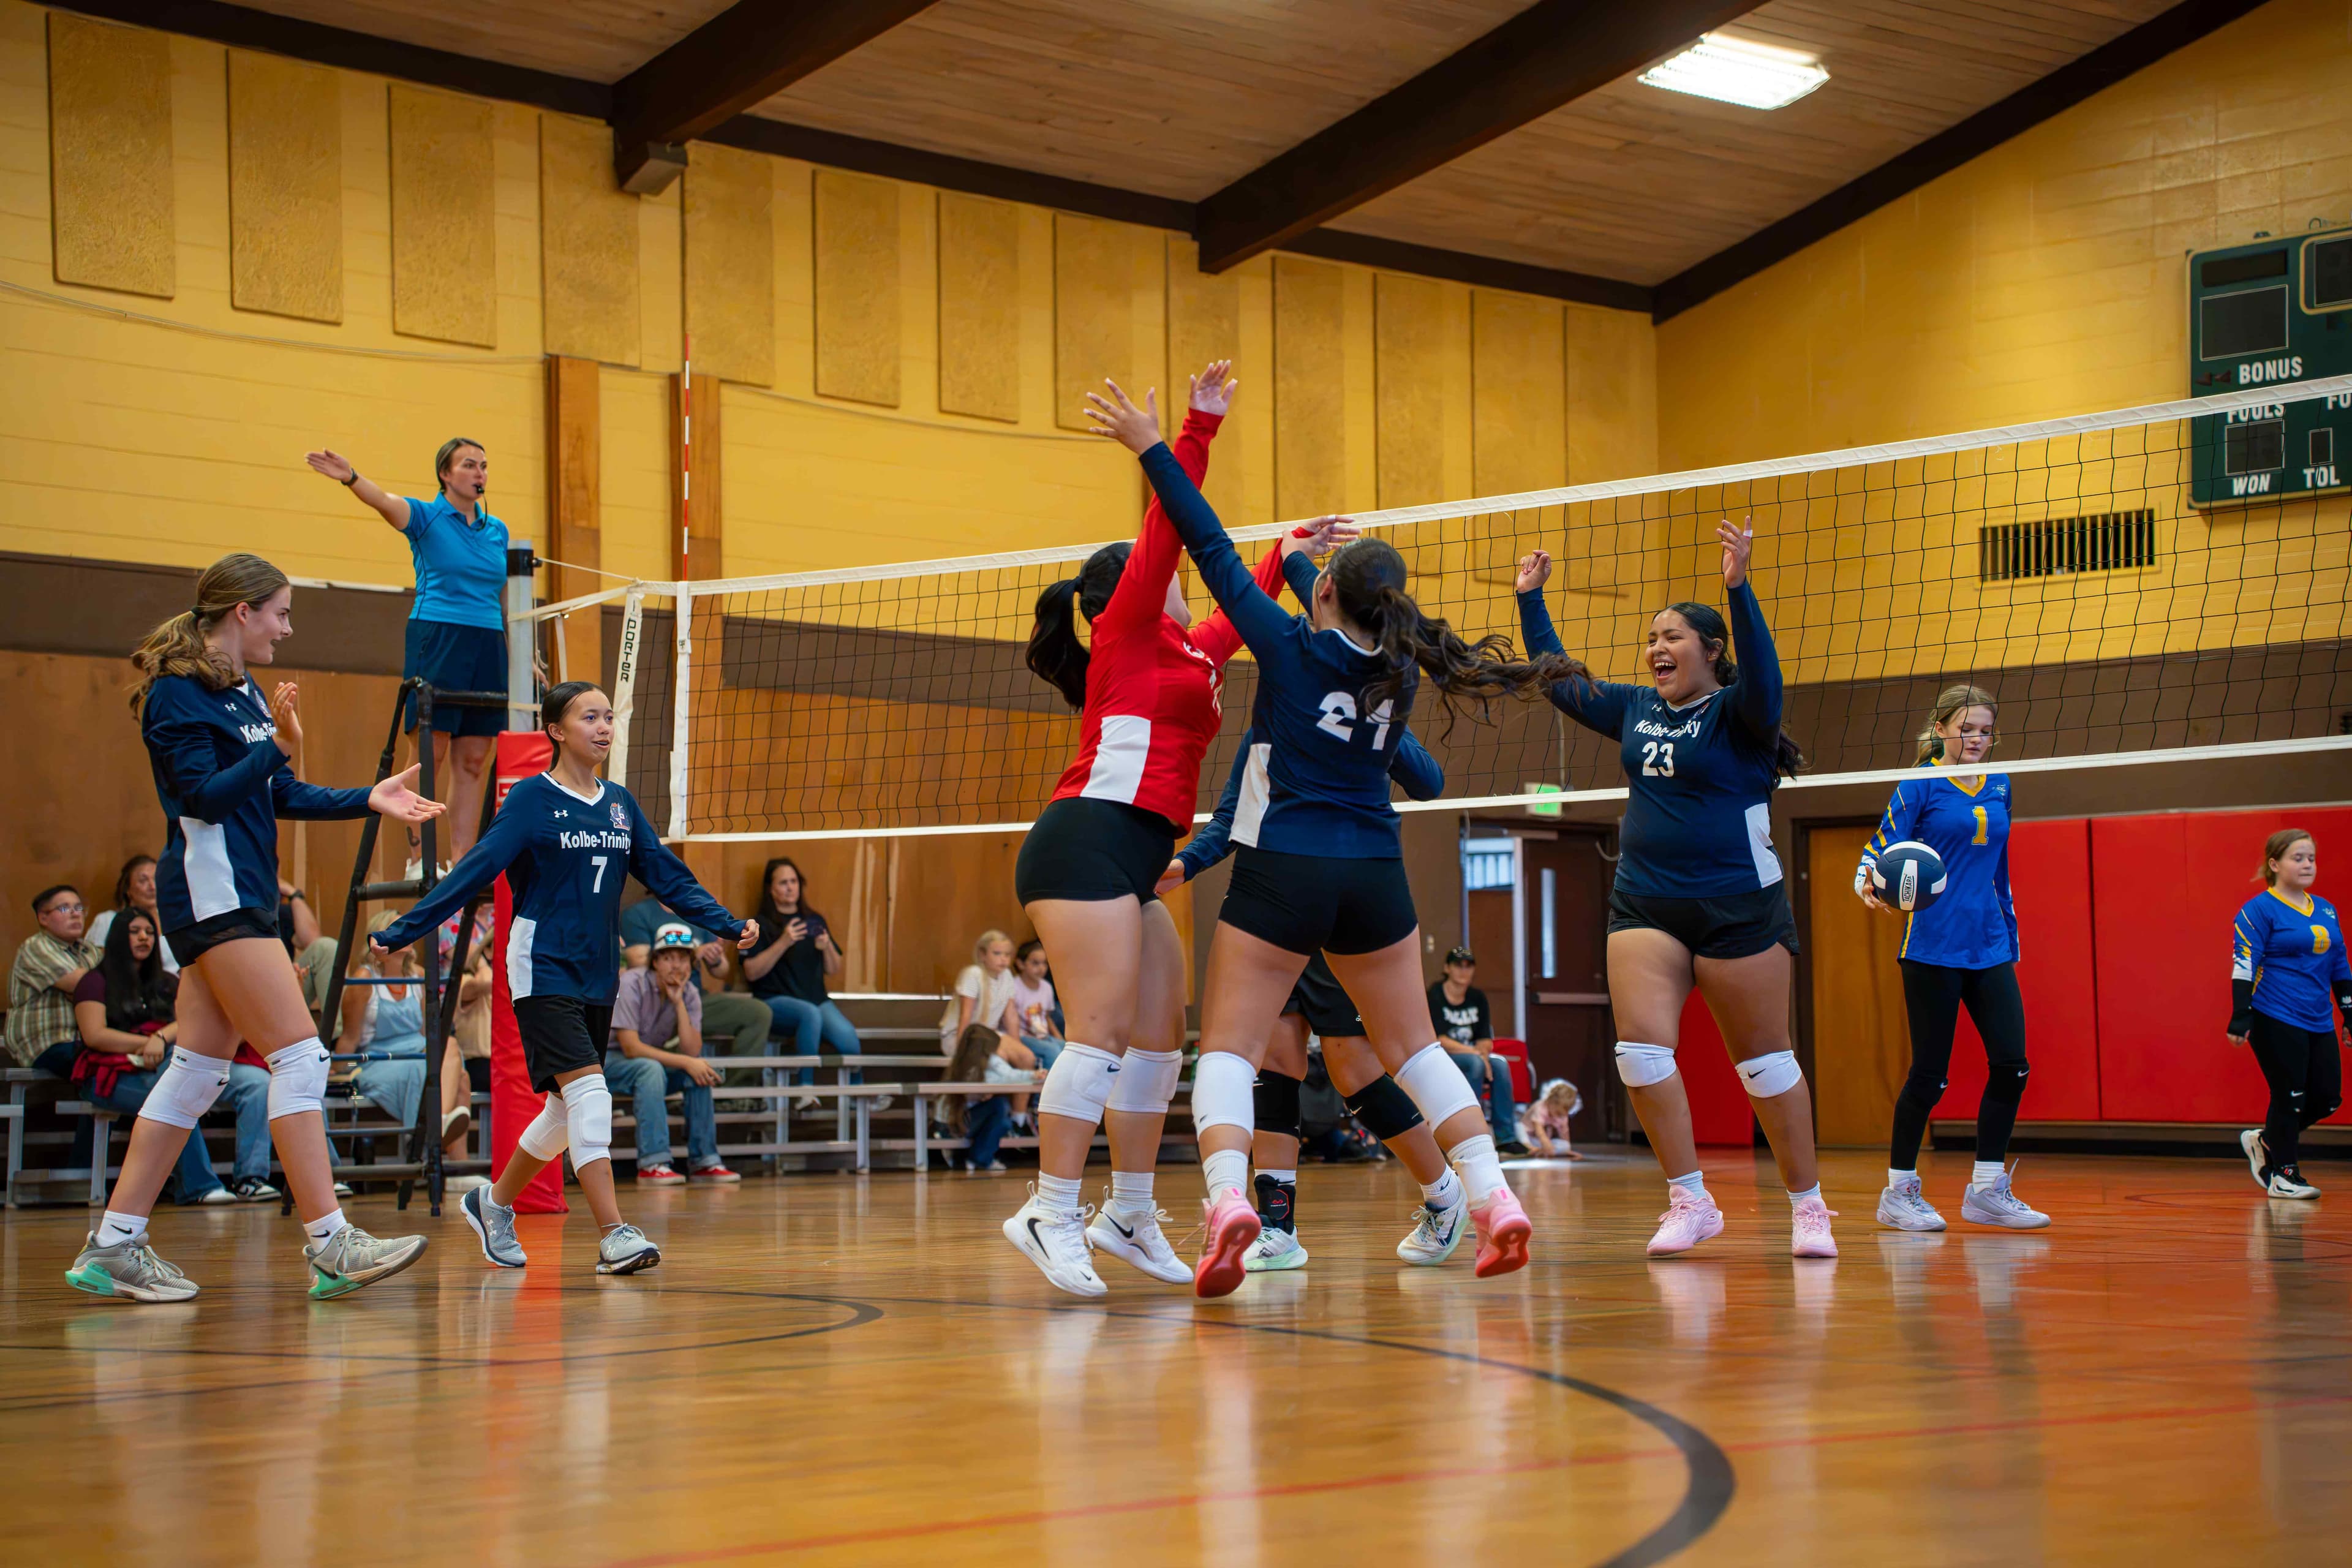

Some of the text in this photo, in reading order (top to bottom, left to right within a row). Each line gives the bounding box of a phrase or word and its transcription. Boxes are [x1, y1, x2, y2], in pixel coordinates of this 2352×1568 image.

[2239, 356, 2303, 385] BONUS
[2233, 473, 2271, 496] WON
[2303, 466, 2340, 489] TOL
[1642, 742, 1674, 777] 23
[1972, 805, 1989, 846] 1
[560, 831, 630, 854] Kolbe-Trinity
[592, 856, 608, 893] 7
